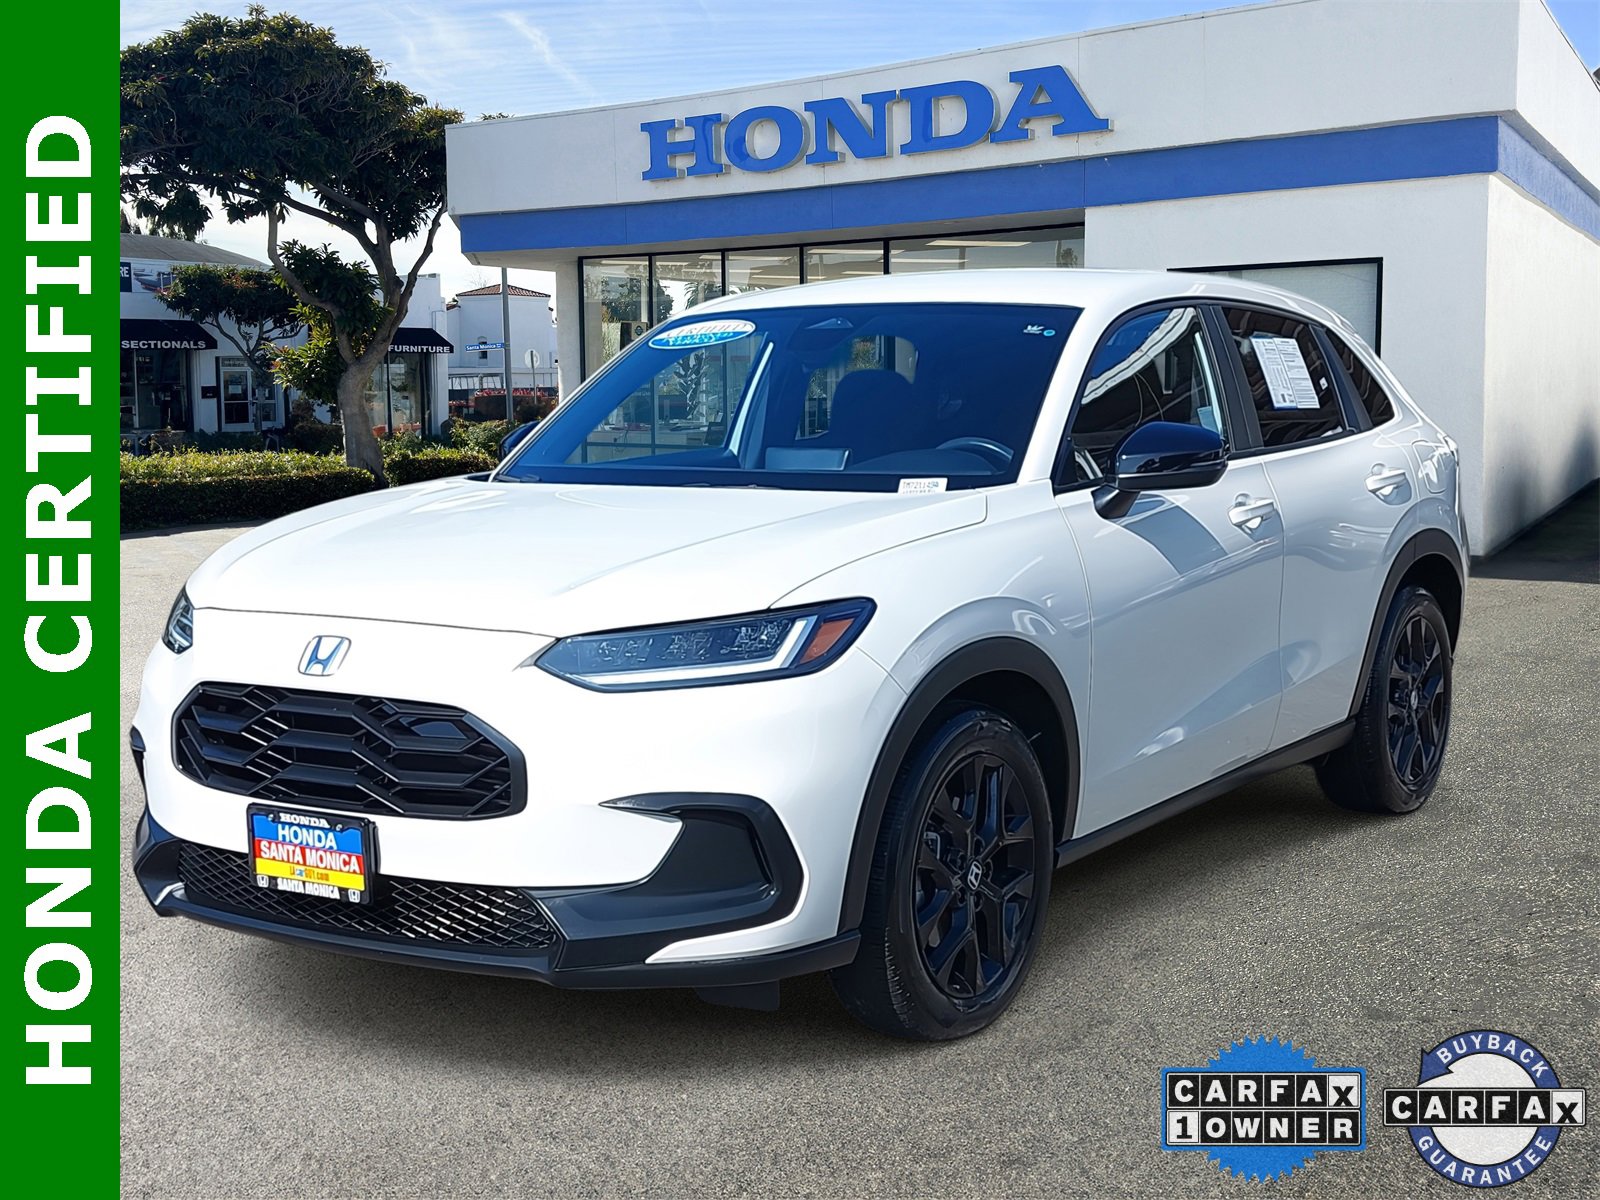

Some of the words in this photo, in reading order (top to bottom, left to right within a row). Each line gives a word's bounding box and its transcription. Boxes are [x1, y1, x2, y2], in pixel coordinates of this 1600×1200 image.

[640, 64, 1113, 182] HONDA
[121, 340, 206, 349] SECTIONALS
[387, 344, 451, 353] FURNITURE
[279, 813, 330, 828] HONDA
[278, 824, 338, 850] HONDA
[260, 841, 303, 865] SANTA
[305, 845, 361, 873] MONICA
[277, 878, 305, 894] SANTA
[305, 882, 341, 900] MONICA
